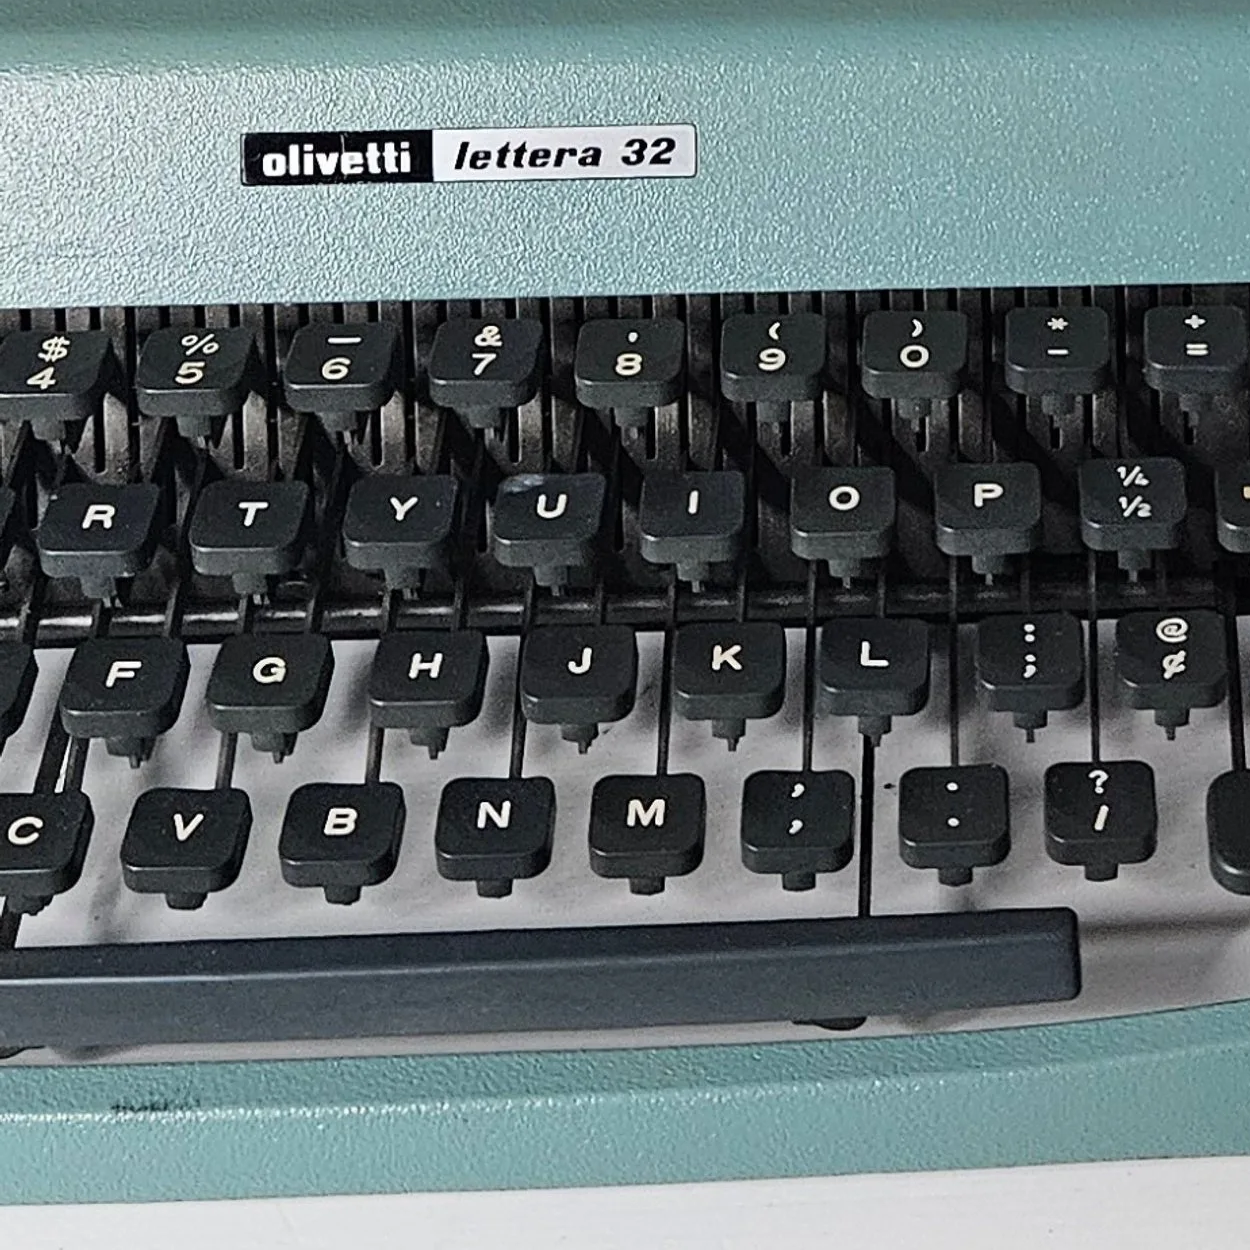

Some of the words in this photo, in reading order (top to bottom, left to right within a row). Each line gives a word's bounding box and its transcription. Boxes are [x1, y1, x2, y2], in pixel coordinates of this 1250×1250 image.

[261, 141, 411, 178] olivetti
[454, 140, 601, 171] lettera
[621, 137, 677, 166] 32
[474, 325, 503, 347] &
[768, 321, 781, 340] (
[911, 318, 923, 338] )
[38, 336, 69, 362] $
[181, 333, 220, 356] %
[321, 357, 351, 380] 6
[472, 353, 497, 376] 7
[615, 353, 643, 376] 8
[758, 348, 786, 371] 9
[26, 365, 57, 391] 4
[175, 361, 206, 385] 5
[390, 496, 418, 521] Y
[536, 493, 567, 519] U
[688, 490, 699, 514] I
[829, 486, 860, 511] O
[974, 483, 1004, 508] P
[82, 504, 116, 529] R
[238, 501, 269, 527] T
[1155, 617, 1189, 643] @
[408, 652, 443, 679] H
[567, 647, 593, 674] J
[711, 644, 742, 671] K
[860, 640, 889, 667] L
[105, 660, 142, 688] F
[252, 656, 286, 684] G
[1088, 769, 1109, 794] ?
[323, 807, 358, 836] B
[477, 800, 512, 829] N
[626, 798, 666, 827] M
[7, 816, 44, 845] C
[173, 813, 204, 841] V
